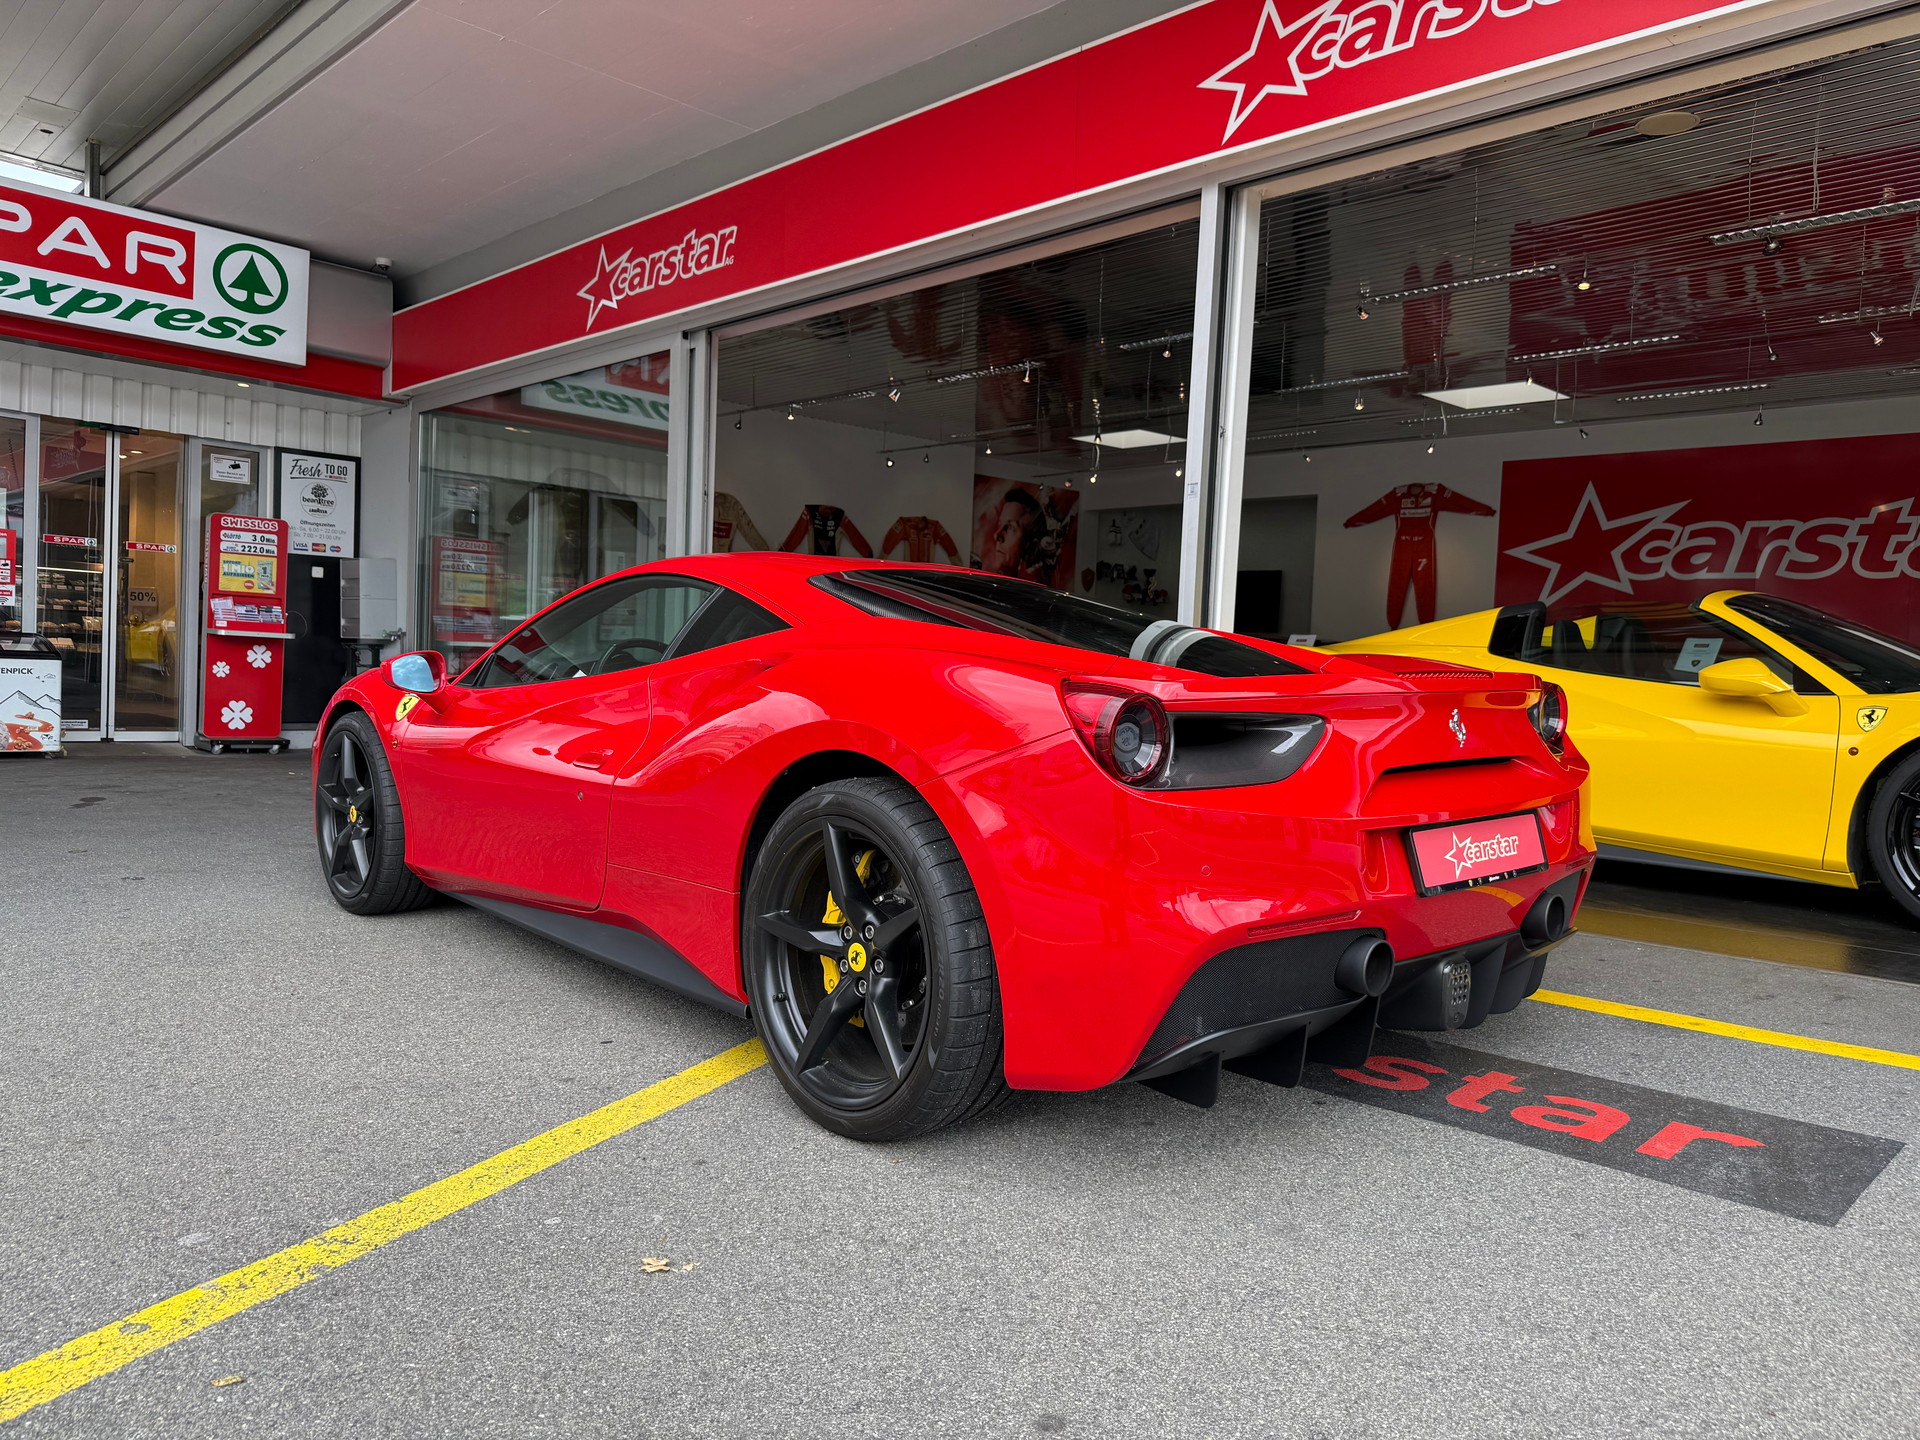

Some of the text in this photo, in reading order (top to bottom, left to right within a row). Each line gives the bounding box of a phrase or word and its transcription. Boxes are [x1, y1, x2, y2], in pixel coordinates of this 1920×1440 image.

[1296, 0, 1562, 81] cars
[611, 225, 738, 300] carstar AG
[289, 458, 348, 477] Fresh TO GO
[221, 516, 278, 531] SWISSLOS
[53, 536, 86, 545] SPAR
[1615, 496, 1920, 580] carst
[135, 543, 166, 551] SPAR
[240, 544, 265, 554] 222.0
[1417, 558, 1428, 571] 7
[129, 591, 156, 602] 50%
[1463, 833, 1519, 863] carstar
[1332, 1054, 1767, 1160] star
